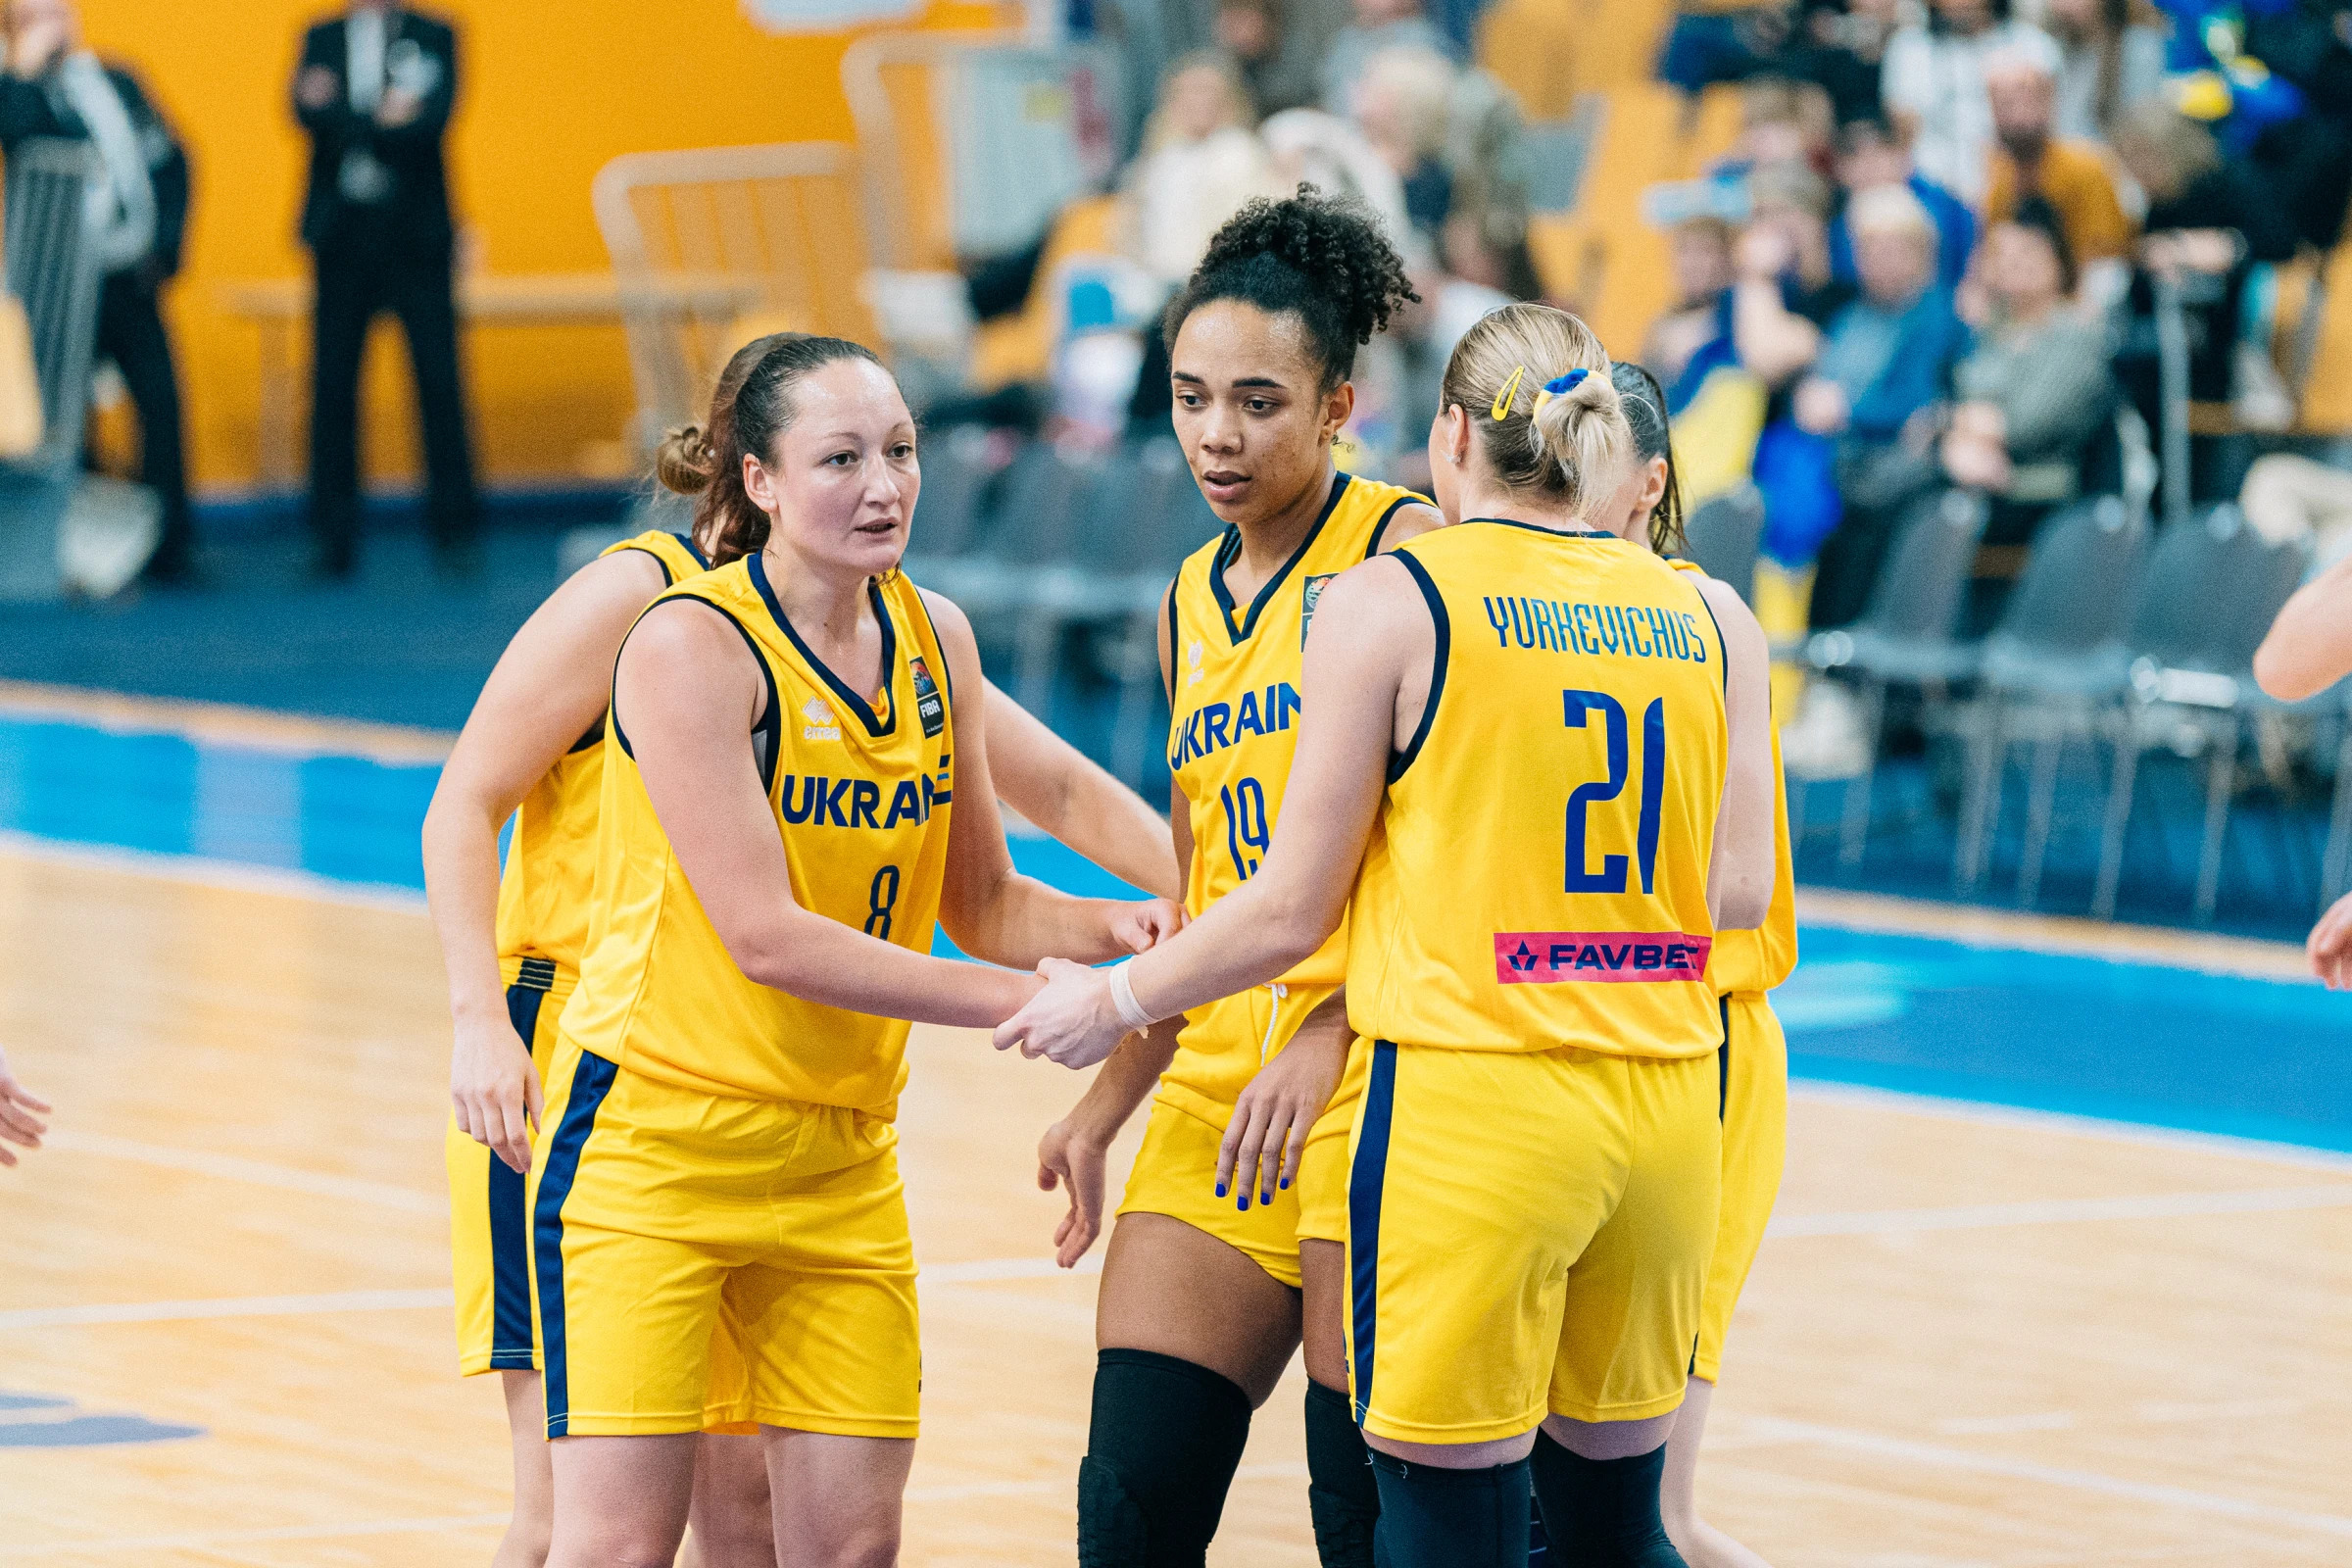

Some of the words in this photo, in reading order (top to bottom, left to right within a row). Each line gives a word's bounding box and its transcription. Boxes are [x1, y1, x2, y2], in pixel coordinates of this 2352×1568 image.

[1483, 597, 1706, 662] YURKEVICHUS
[919, 699, 941, 718] FIBA
[1171, 682, 1301, 770] UKRAIN
[1221, 777, 1270, 881] 19
[1562, 689, 1666, 895] 21
[864, 864, 901, 942] 8
